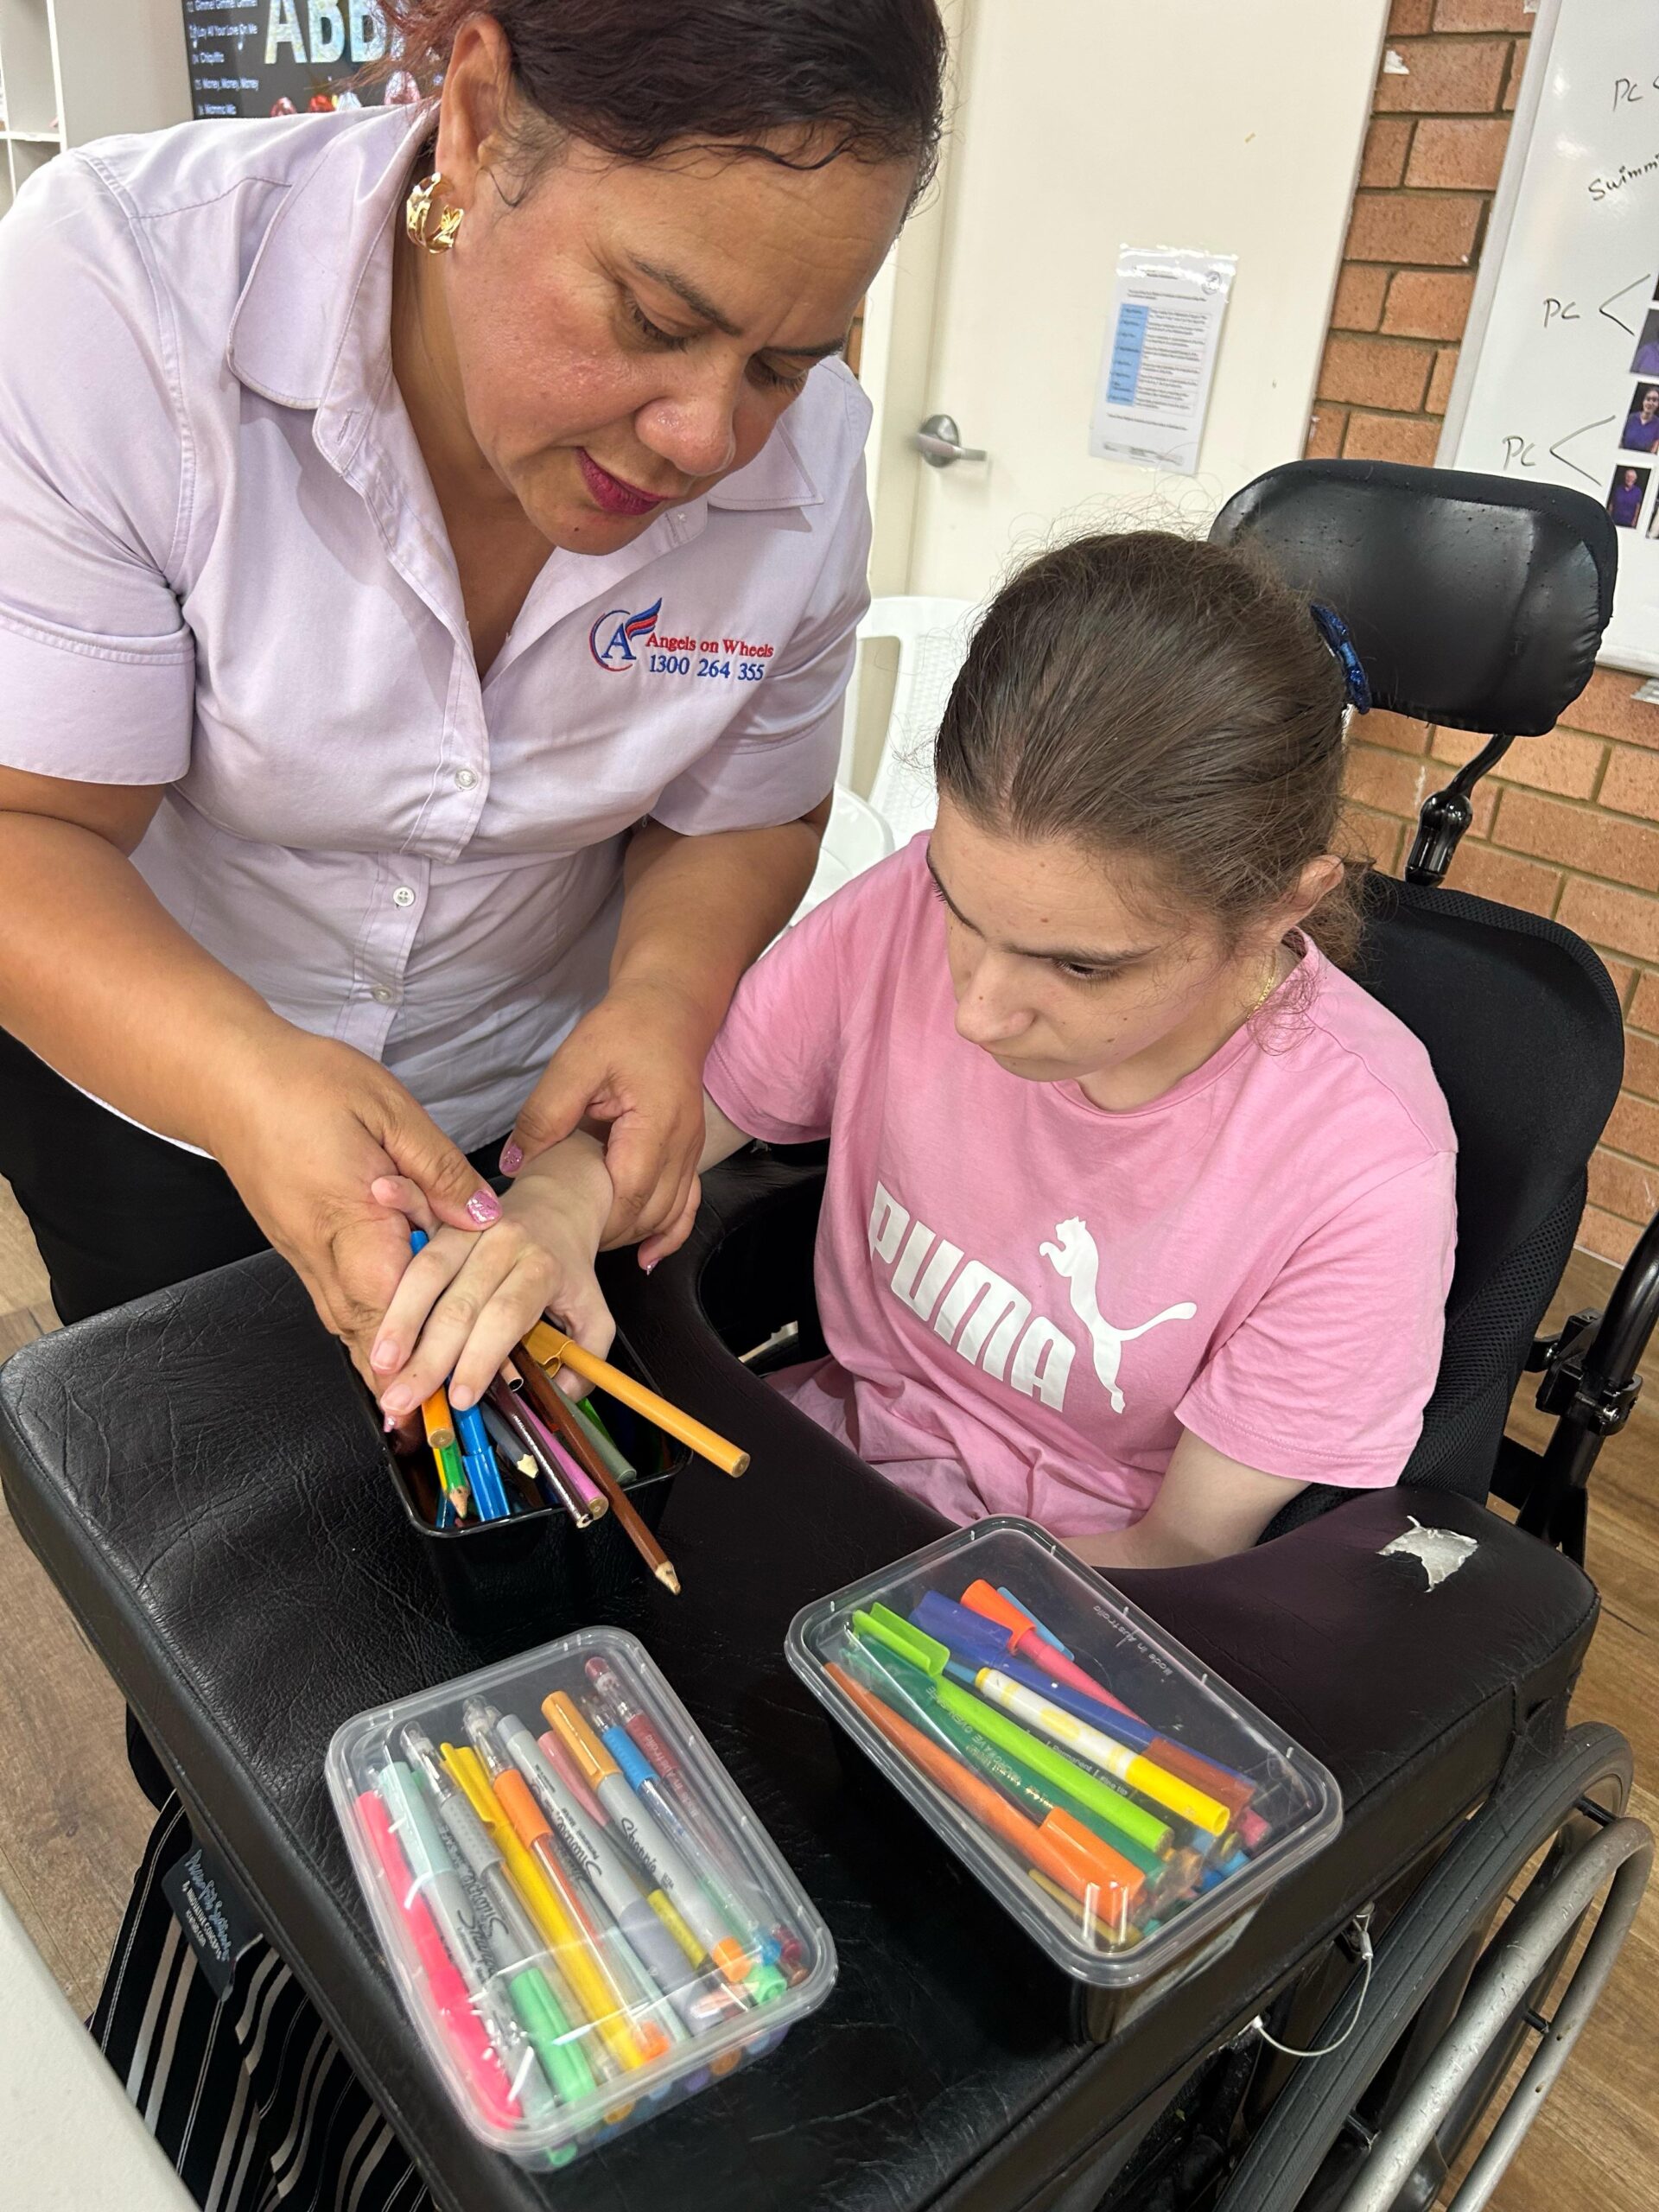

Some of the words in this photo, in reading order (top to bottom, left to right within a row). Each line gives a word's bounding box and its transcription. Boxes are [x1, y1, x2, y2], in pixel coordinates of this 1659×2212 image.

[645, 632, 696, 652] Angels
[700, 639, 719, 653] on
[722, 639, 774, 658] Wheels
[649, 654, 690, 675] 1300
[696, 658, 731, 679] 264
[737, 662, 766, 681] 355
[868, 1180, 1077, 1413] PUMA
[1093, 1605, 1138, 1644] Australia
[1136, 1642, 1147, 1654] in
[1147, 1652, 1173, 1677] Made
[187, 1887, 207, 1923] INNOVATIVE
[203, 1922, 222, 1960] CONCEPTS
